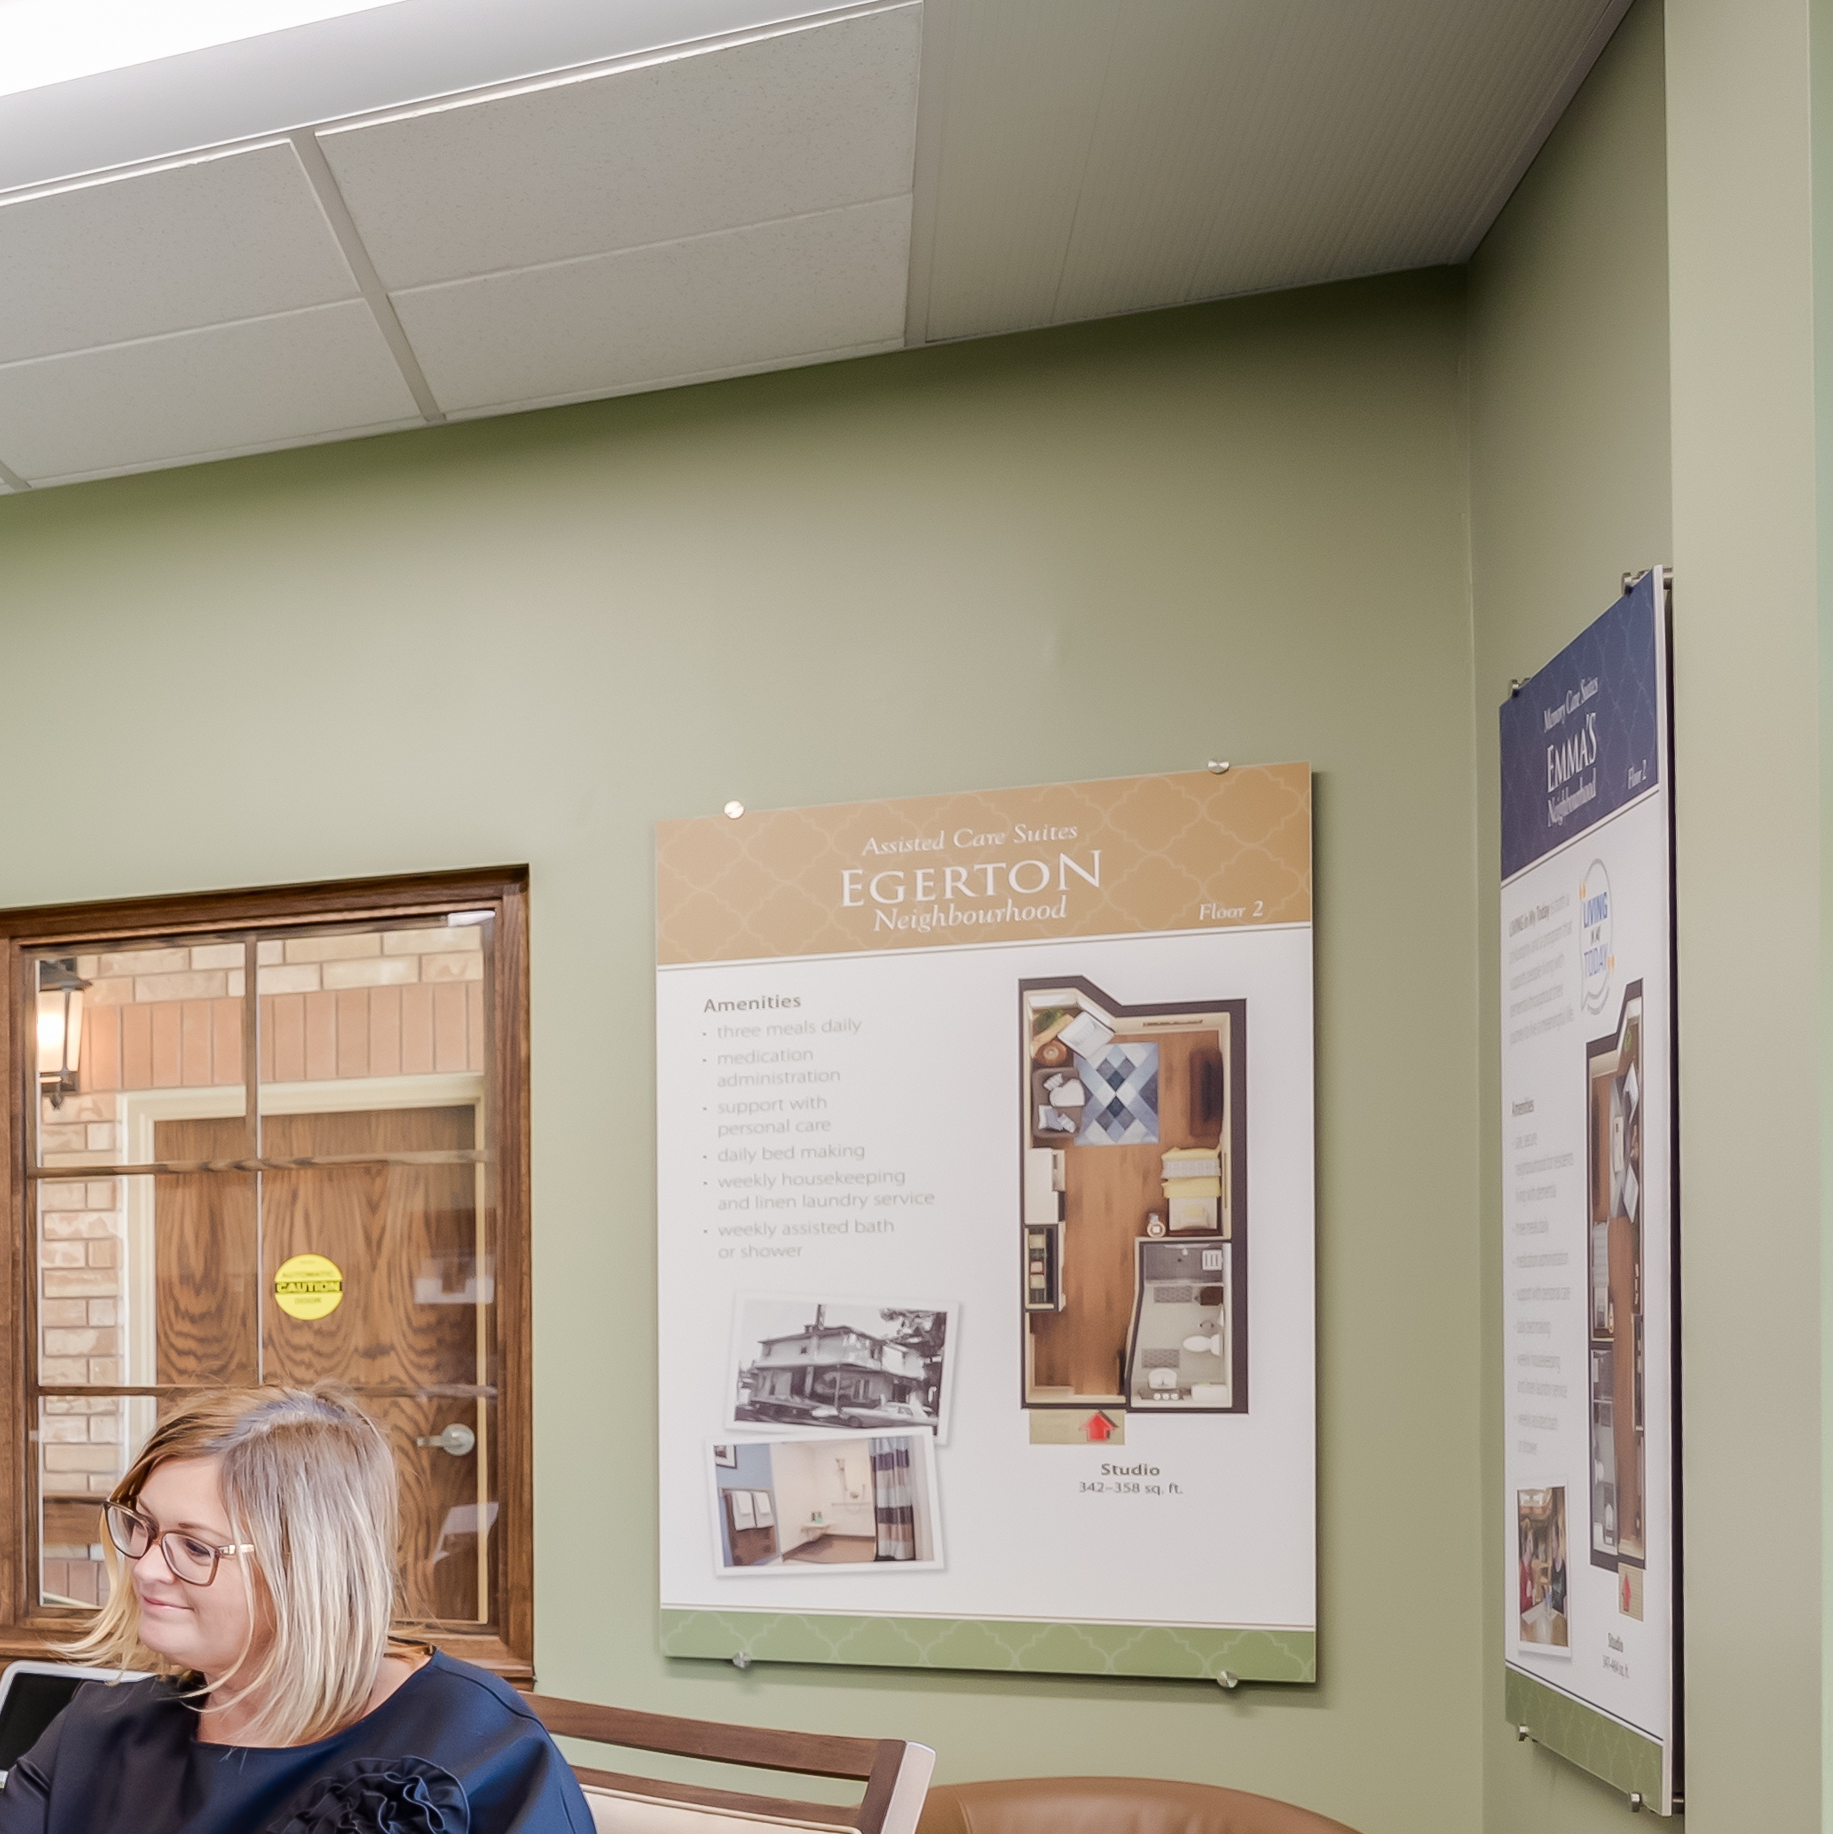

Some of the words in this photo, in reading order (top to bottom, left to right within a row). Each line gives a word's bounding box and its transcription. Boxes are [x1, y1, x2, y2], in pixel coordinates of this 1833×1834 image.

[1547, 712, 1596, 793] EMMA'S
[861, 831, 945, 857] Assisted
[953, 827, 1006, 849] Care
[1013, 823, 1078, 844] Suites
[840, 849, 1103, 909] EGERTON
[873, 895, 1068, 934] Neighbourhood
[1198, 902, 1244, 921] Floor
[1253, 900, 1264, 918] 2
[704, 994, 801, 1013] Amenities
[717, 1024, 761, 1039] three
[766, 1020, 816, 1036] meals
[821, 1017, 862, 1035] daily
[717, 1048, 814, 1065] medication
[717, 1069, 841, 1088] administration
[717, 1098, 784, 1116] support
[790, 1095, 827, 1111] with
[717, 1119, 790, 1138] personal
[795, 1119, 831, 1133] care
[717, 1148, 757, 1164] daily
[762, 1146, 795, 1160] bed
[800, 1144, 865, 1160] making
[718, 1173, 776, 1190] weekly
[782, 1170, 906, 1187] housekeeping
[718, 1195, 750, 1211] and
[755, 1196, 797, 1209] linen
[803, 1192, 869, 1210] laundry
[874, 1191, 935, 1206] service
[718, 1221, 776, 1238] weekly
[782, 1219, 849, 1236] assisted
[854, 1219, 895, 1234] bath
[718, 1246, 735, 1259] or
[740, 1244, 803, 1258] shower
[277, 1281, 340, 1293] CAUTION
[1101, 1463, 1160, 1476] Studio
